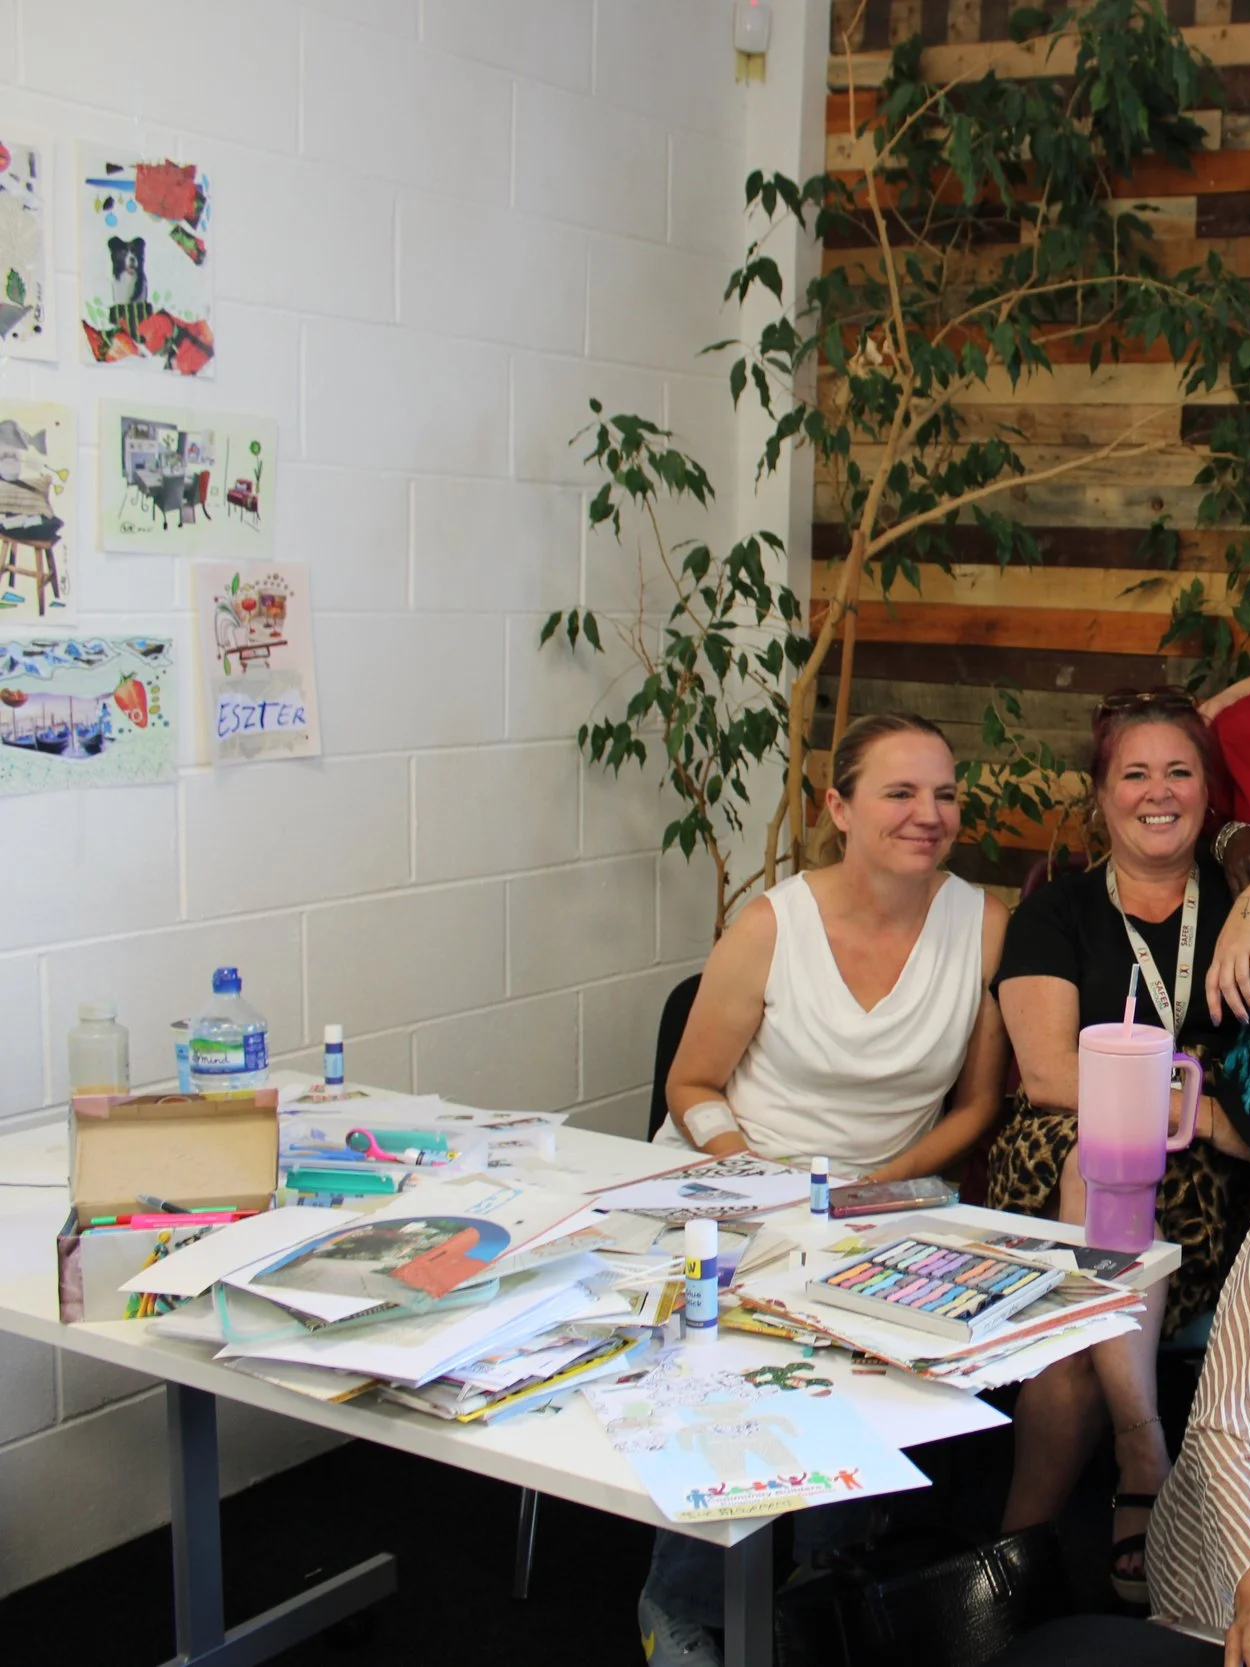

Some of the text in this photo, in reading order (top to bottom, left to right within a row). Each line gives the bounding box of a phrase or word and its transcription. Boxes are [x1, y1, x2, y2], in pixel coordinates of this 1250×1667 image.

[217, 702, 306, 737] ESZTER
[1180, 925, 1190, 947] SAFER
[1154, 980, 1170, 1009] SAFER
